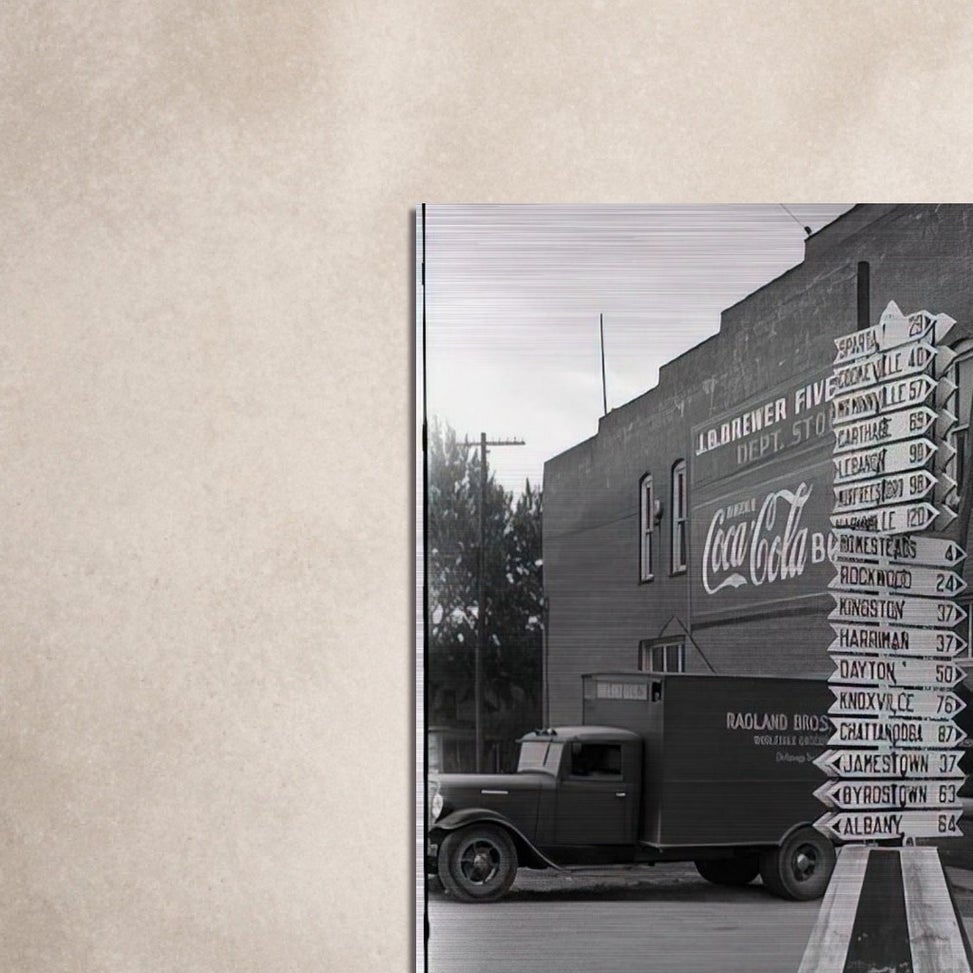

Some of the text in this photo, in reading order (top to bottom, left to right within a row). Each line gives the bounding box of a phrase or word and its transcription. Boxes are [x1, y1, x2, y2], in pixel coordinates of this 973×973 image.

[908, 346, 926, 368] 40
[795, 375, 837, 414] FIVE
[909, 380, 924, 401] 57
[909, 443, 924, 463] 90
[909, 474, 924, 494] 98
[906, 506, 925, 527] 120
[840, 566, 955, 593] ROCKWOOD 24
[839, 597, 954, 622] KINGSTON 37
[840, 629, 954, 652] HARRIMAN 37
[840, 659, 953, 683] DAYTON 50
[839, 692, 953, 714] KNOXVILLE 76
[840, 722, 954, 743] CHATTANOOGA 87
[843, 752, 957, 775] JAMESTOWN 37
[843, 785, 928, 804] BYRDSTOWN
[843, 815, 957, 836] ALBANY 64
